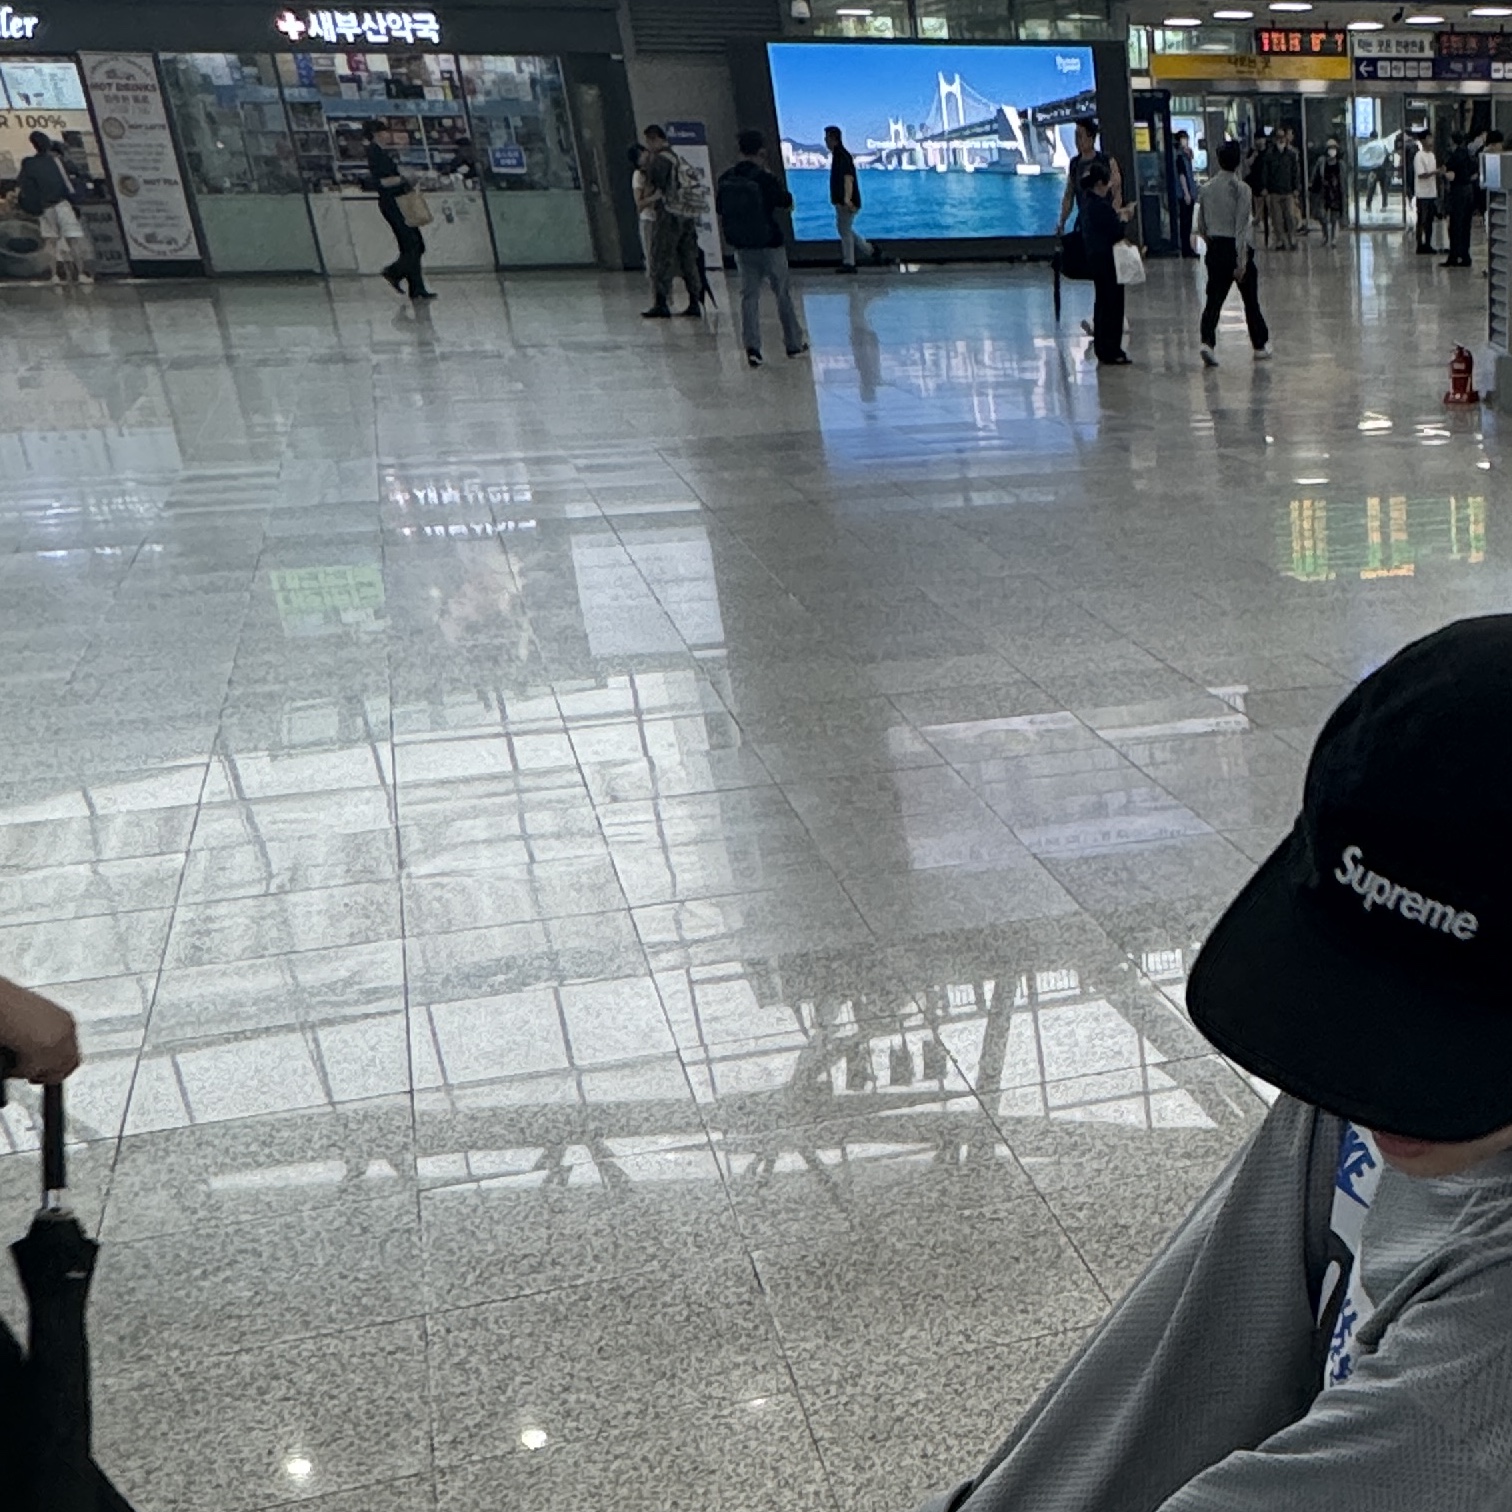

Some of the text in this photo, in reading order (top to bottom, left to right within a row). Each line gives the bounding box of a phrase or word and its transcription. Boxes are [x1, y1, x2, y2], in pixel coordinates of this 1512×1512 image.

[307, 9, 440, 44] 새부산약국
[14, 115, 67, 129] 100%
[1334, 845, 1479, 941] Supreme
